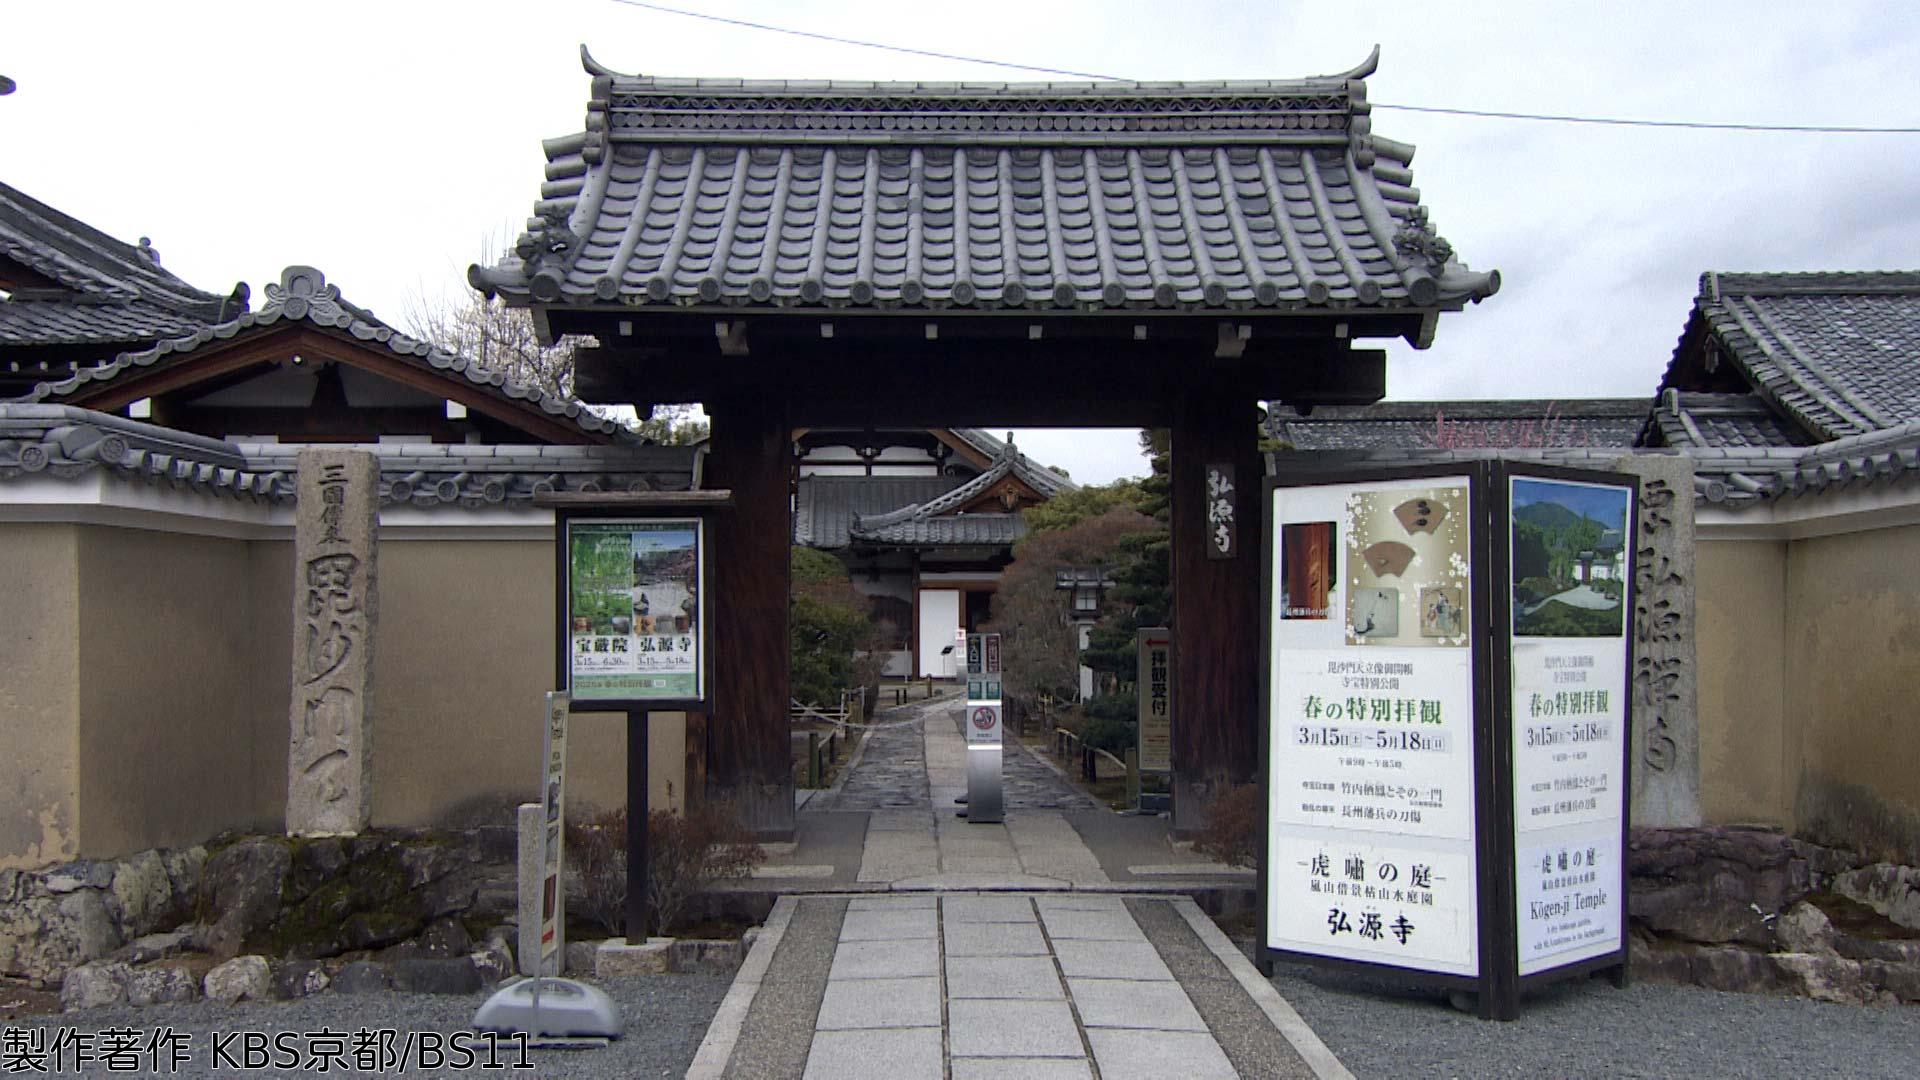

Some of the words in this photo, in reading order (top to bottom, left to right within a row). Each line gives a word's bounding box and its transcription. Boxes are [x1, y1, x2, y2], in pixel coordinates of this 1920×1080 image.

[1151, 651, 1168, 716] 拝観受付
[1342, 677, 1400, 690] 寺宝特別公開
[1304, 695, 1442, 724] 春の特別拝観
[1530, 690, 1609, 718] 春の特別拝観
[1310, 879, 1433, 906] 嵐山借景枯山水庭園
[1574, 888, 1607, 911] Temple
[1327, 908, 1415, 945] 弘源寺
